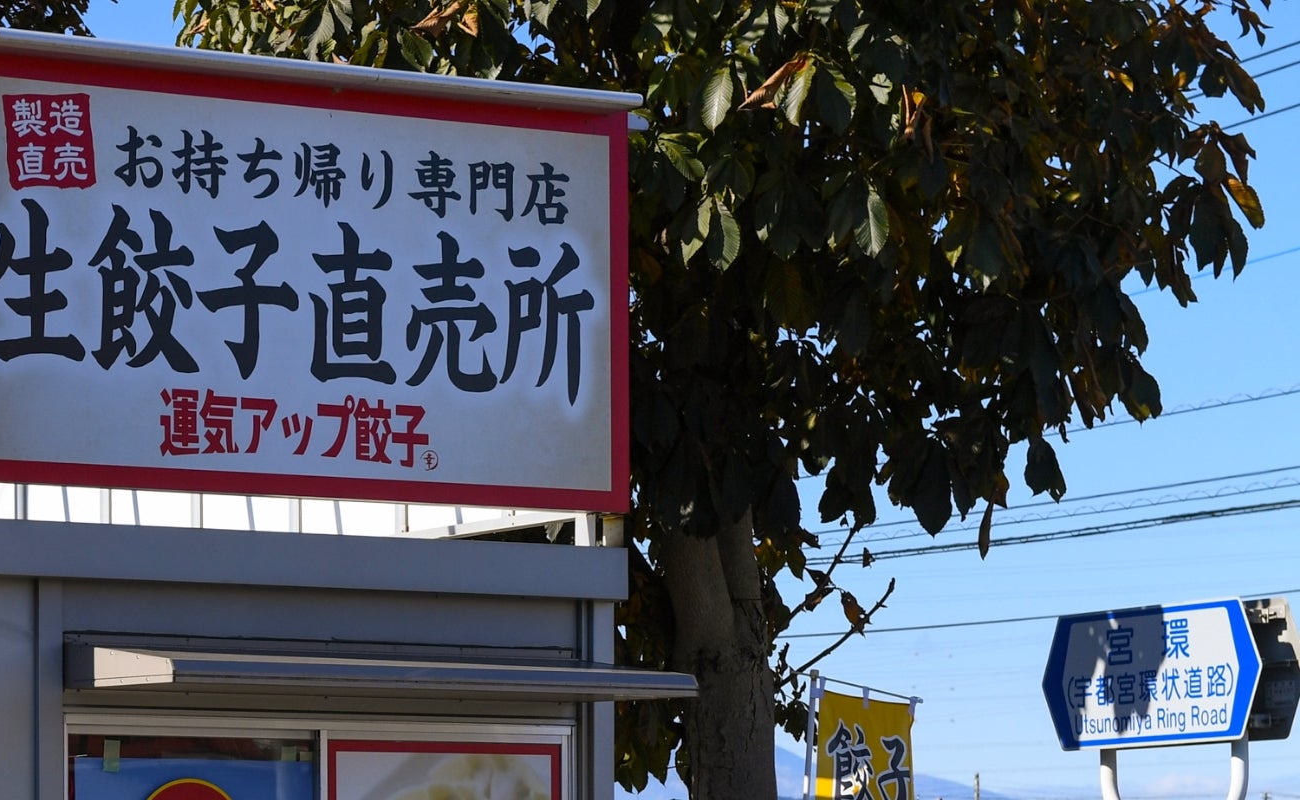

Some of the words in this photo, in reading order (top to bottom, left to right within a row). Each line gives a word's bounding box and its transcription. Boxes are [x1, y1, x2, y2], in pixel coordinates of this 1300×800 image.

[12, 98, 84, 137] 製造
[17, 142, 88, 181] 直売
[114, 125, 569, 226] お持ち帰り専門店
[160, 388, 429, 468] 運気アップ餃子
[1067, 662, 1234, 710] (宇都宮環状道路)
[1075, 710, 1152, 736] Utsunomiya
[1157, 708, 1186, 733] Ring
[1191, 704, 1227, 727] Road
[826, 718, 911, 800] 餃子
